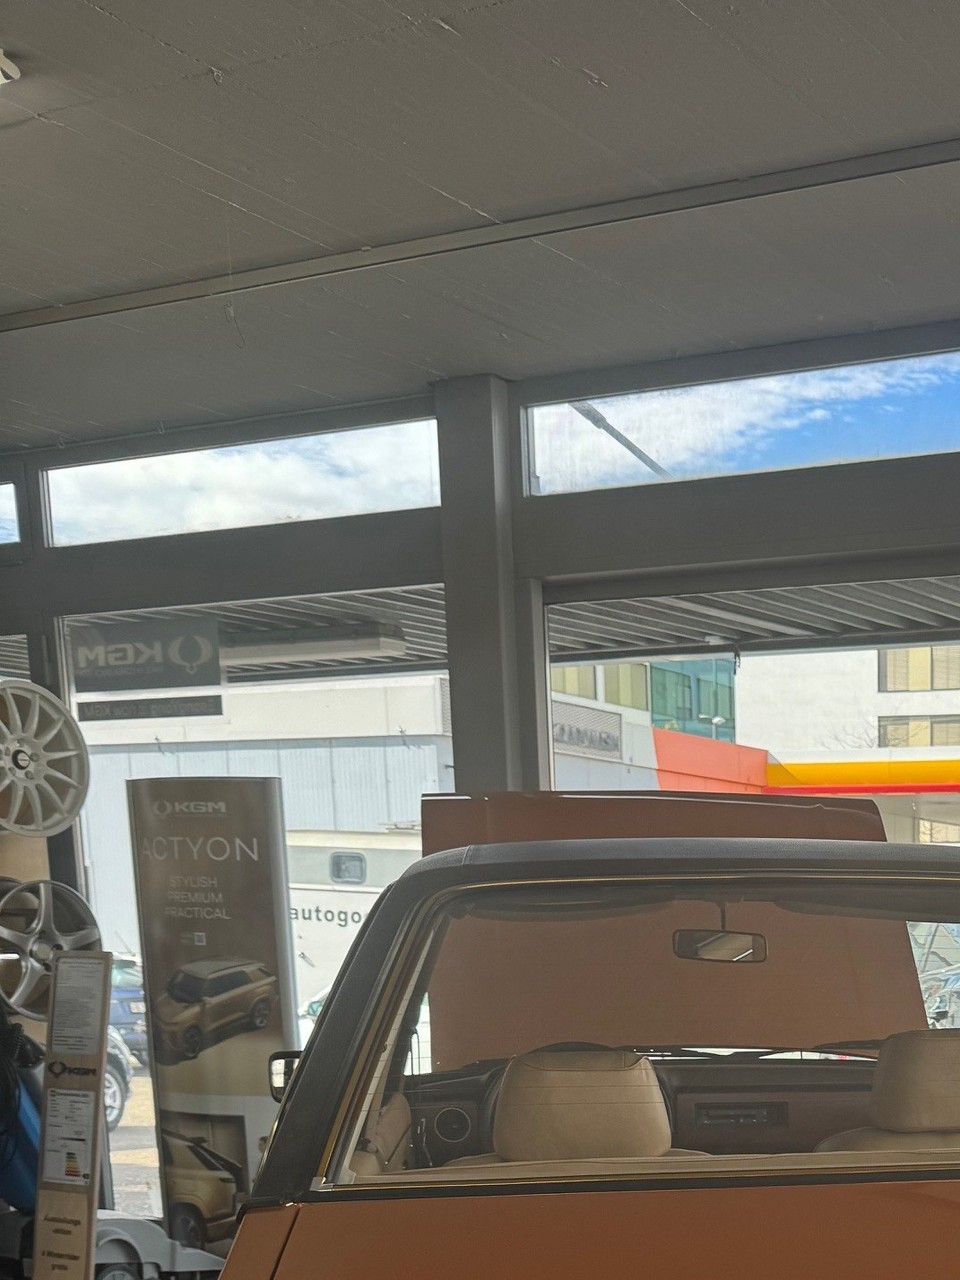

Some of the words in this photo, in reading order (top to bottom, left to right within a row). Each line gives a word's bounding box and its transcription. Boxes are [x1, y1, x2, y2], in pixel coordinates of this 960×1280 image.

[174, 801, 227, 813] KGM
[141, 836, 259, 862] ACTYON
[168, 876, 218, 888] STYLISH
[167, 891, 224, 904] PREMIUM
[165, 906, 232, 920] PRACTICAL
[290, 905, 369, 927] autogo
